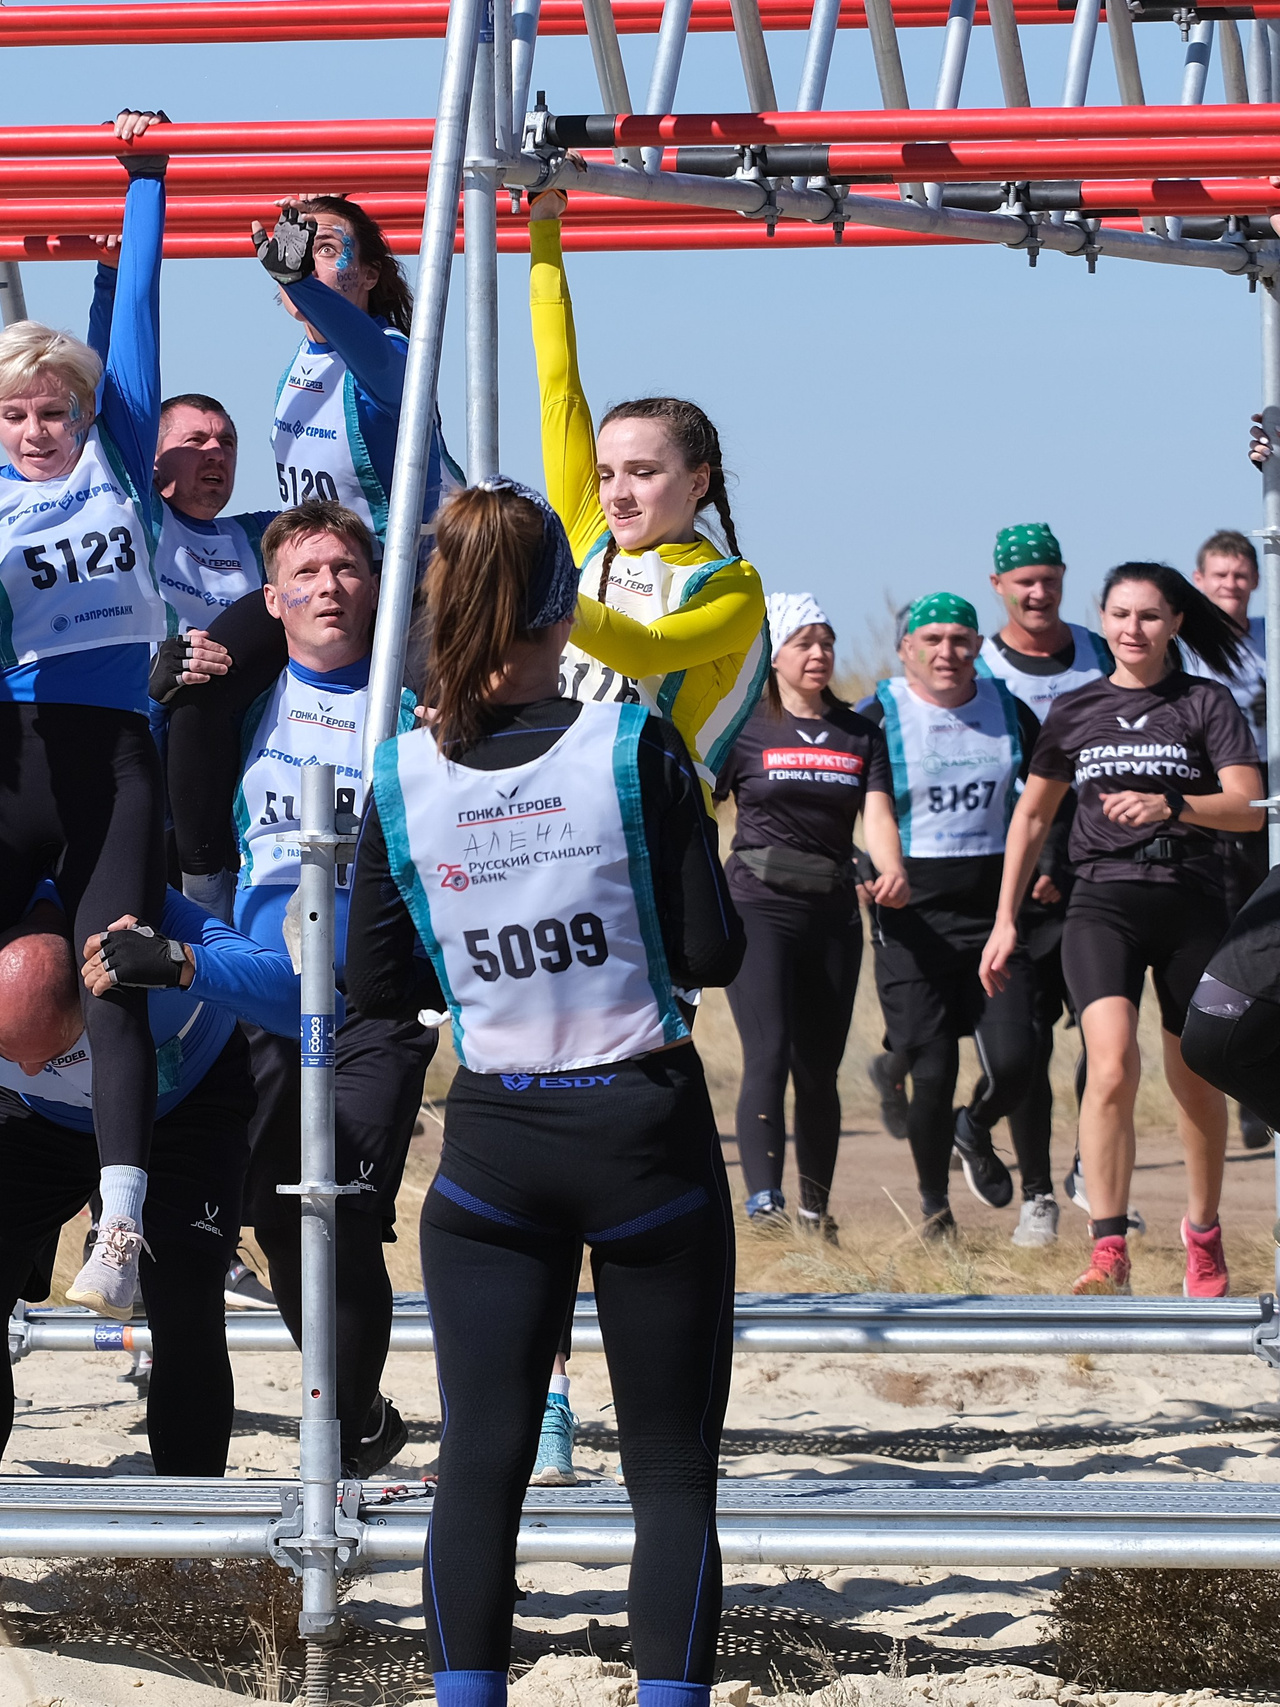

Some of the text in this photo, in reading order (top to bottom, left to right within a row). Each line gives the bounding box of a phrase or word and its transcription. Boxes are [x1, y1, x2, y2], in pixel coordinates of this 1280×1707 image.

[306, 426, 337, 440] СЕРВИС
[23, 526, 136, 591] 5123
[160, 574, 203, 599] ВОСТОК
[74, 605, 134, 623] ГАЗПРОМБАНК
[290, 709, 356, 730] ГОНКА ГЕРОЕВ
[767, 753, 859, 770] ИНСТРУКТОР
[1079, 743, 1188, 763] СТАРШИЙ
[768, 769, 813, 781] ГОНКА
[928, 781, 997, 814] 5167
[458, 796, 563, 823] ГОНКА ГЕРОЕВ
[469, 845, 602, 874] РУССКИЙ СТАНДАРТ
[471, 871, 508, 886] БАНК
[463, 912, 610, 982] 5099
[311, 1016, 320, 1053] СОЮЗ
[539, 1073, 618, 1089] ESDY
[190, 1219, 224, 1237] JÖGEL
